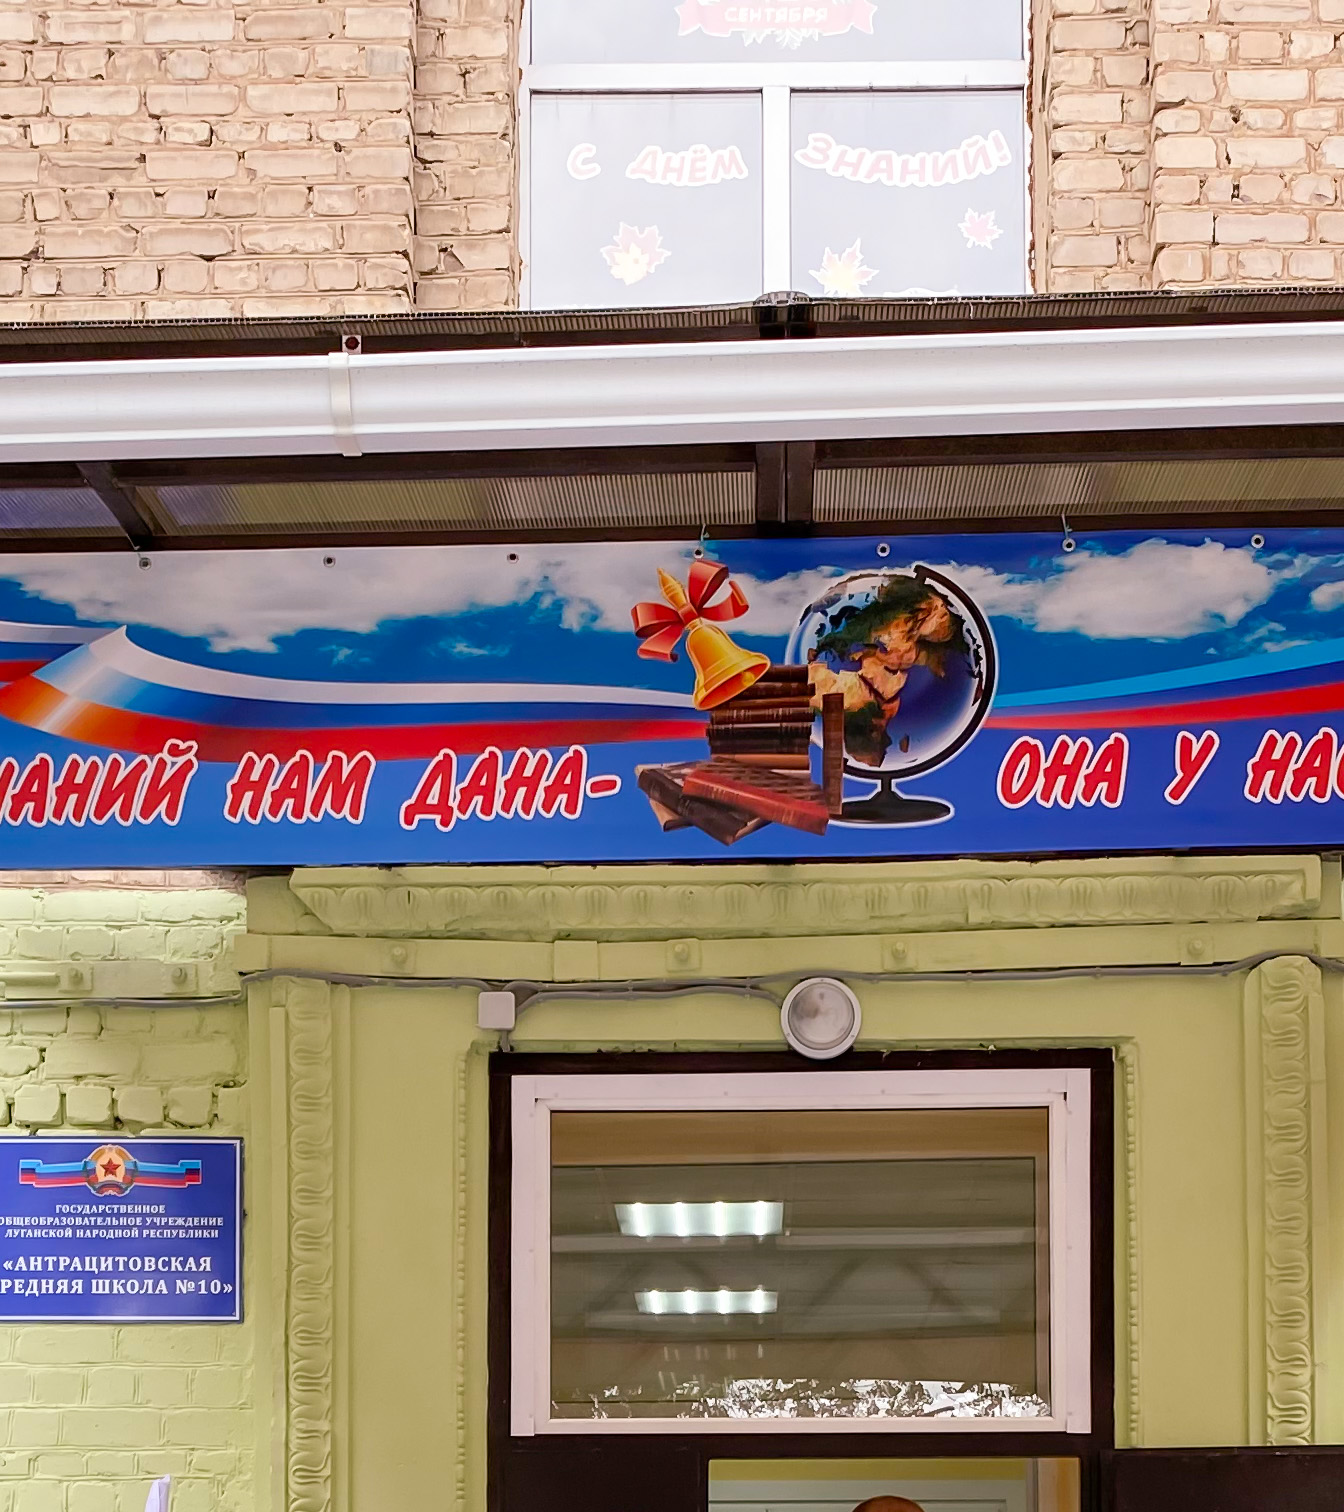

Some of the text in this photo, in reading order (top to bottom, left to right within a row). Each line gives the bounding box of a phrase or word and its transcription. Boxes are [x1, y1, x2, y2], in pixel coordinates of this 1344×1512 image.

[724, 6, 828, 23] СЕНТЯБРЯ
[567, 130, 1013, 188] С ДНЁМ ЗНАНИЙ!
[223, 750, 376, 826] НАМ
[400, 744, 622, 832] ДАНА-
[996, 732, 1128, 810] ОНА
[1163, 731, 1220, 805] У
[55, 1204, 166, 1215] ГОСУДАРСТВЕННОЕ
[145, 1216, 224, 1227] УЧРЕЖДЕНИЕ
[4, 1227, 219, 1240] ЛУГАНСКОЙ НАРОДНОЙ РЕСПУБЛИКИ
[2, 1256, 212, 1274] «АНТРАЦИТОВСКАЯ
[91, 1279, 169, 1295] ШКОЛА
[175, 1279, 233, 1295] №10»
